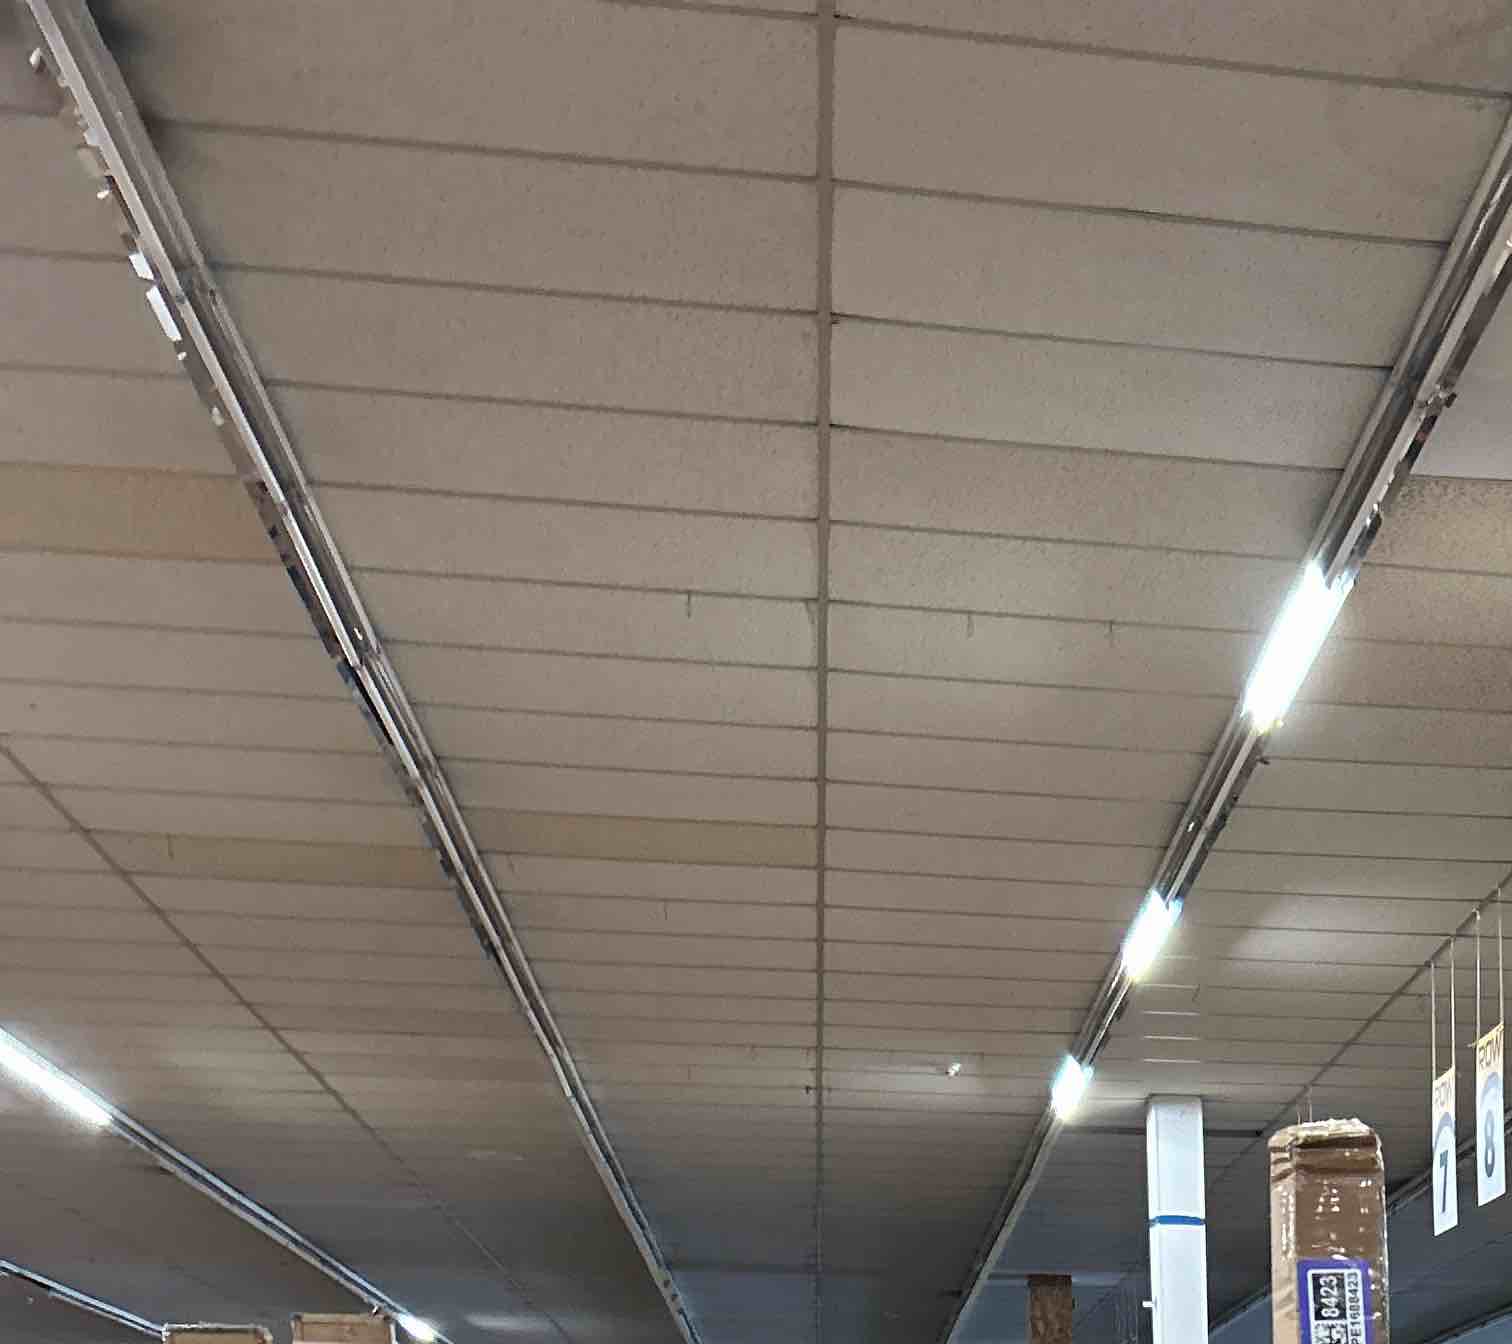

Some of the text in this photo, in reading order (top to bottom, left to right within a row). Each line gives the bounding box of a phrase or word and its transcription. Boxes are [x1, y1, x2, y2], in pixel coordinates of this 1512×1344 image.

[1478, 1032, 1502, 1069] ROW
[1484, 1109, 1495, 1177] 8
[1439, 1150, 1448, 1213] 7
[1320, 1275, 1339, 1318] 8423
